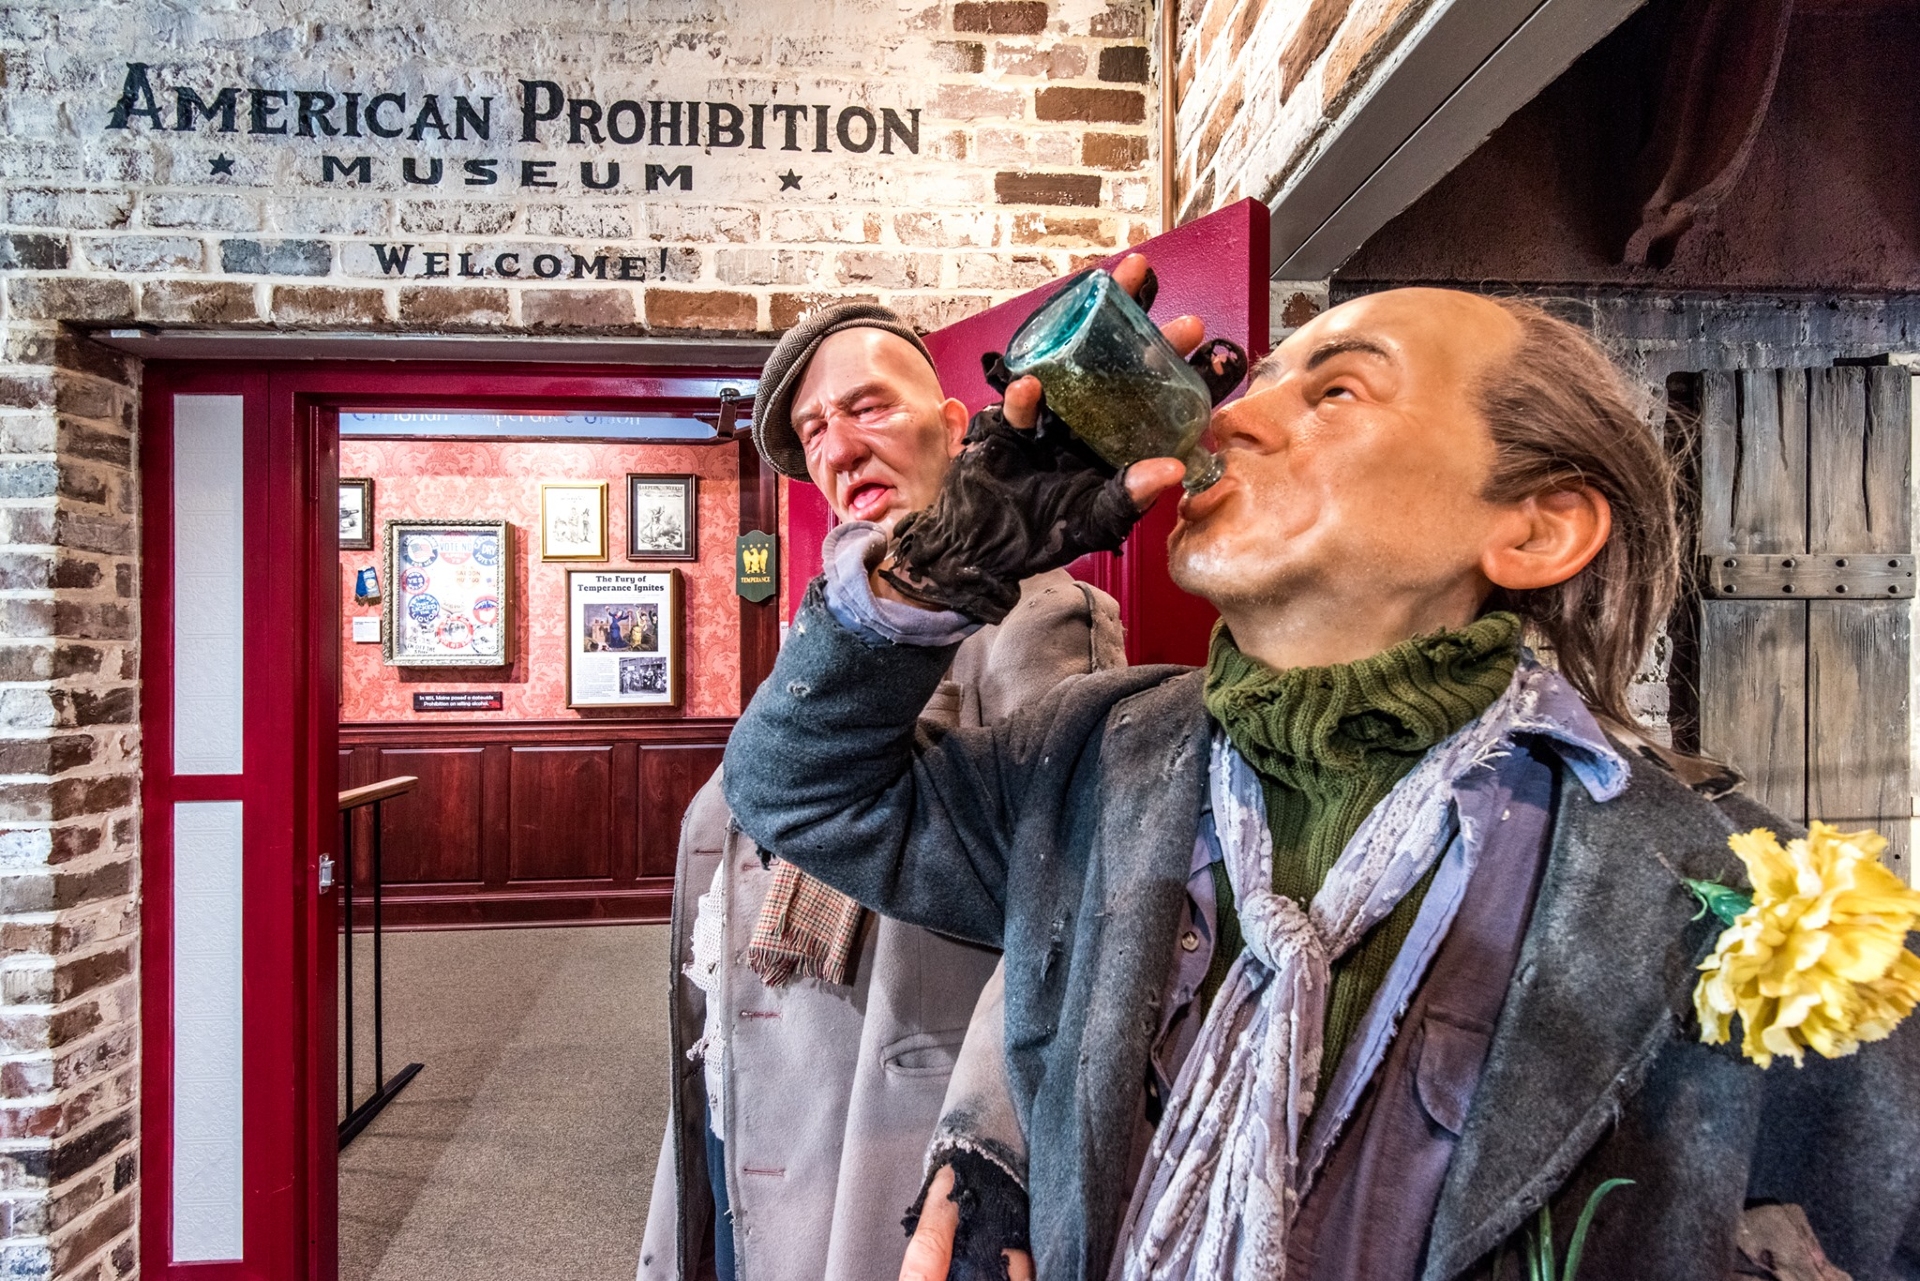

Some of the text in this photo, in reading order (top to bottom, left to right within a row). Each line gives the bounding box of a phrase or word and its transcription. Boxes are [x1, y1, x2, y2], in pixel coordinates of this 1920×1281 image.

[105, 61, 922, 156] AMERICAN PROHIBITION
[322, 155, 693, 192] MUSEUM
[369, 243, 670, 283] WELCOME!
[577, 583, 665, 593] Temperance Ignites
[596, 575, 647, 584] The Fury of
[740, 576, 771, 584] TEMPERANCE
